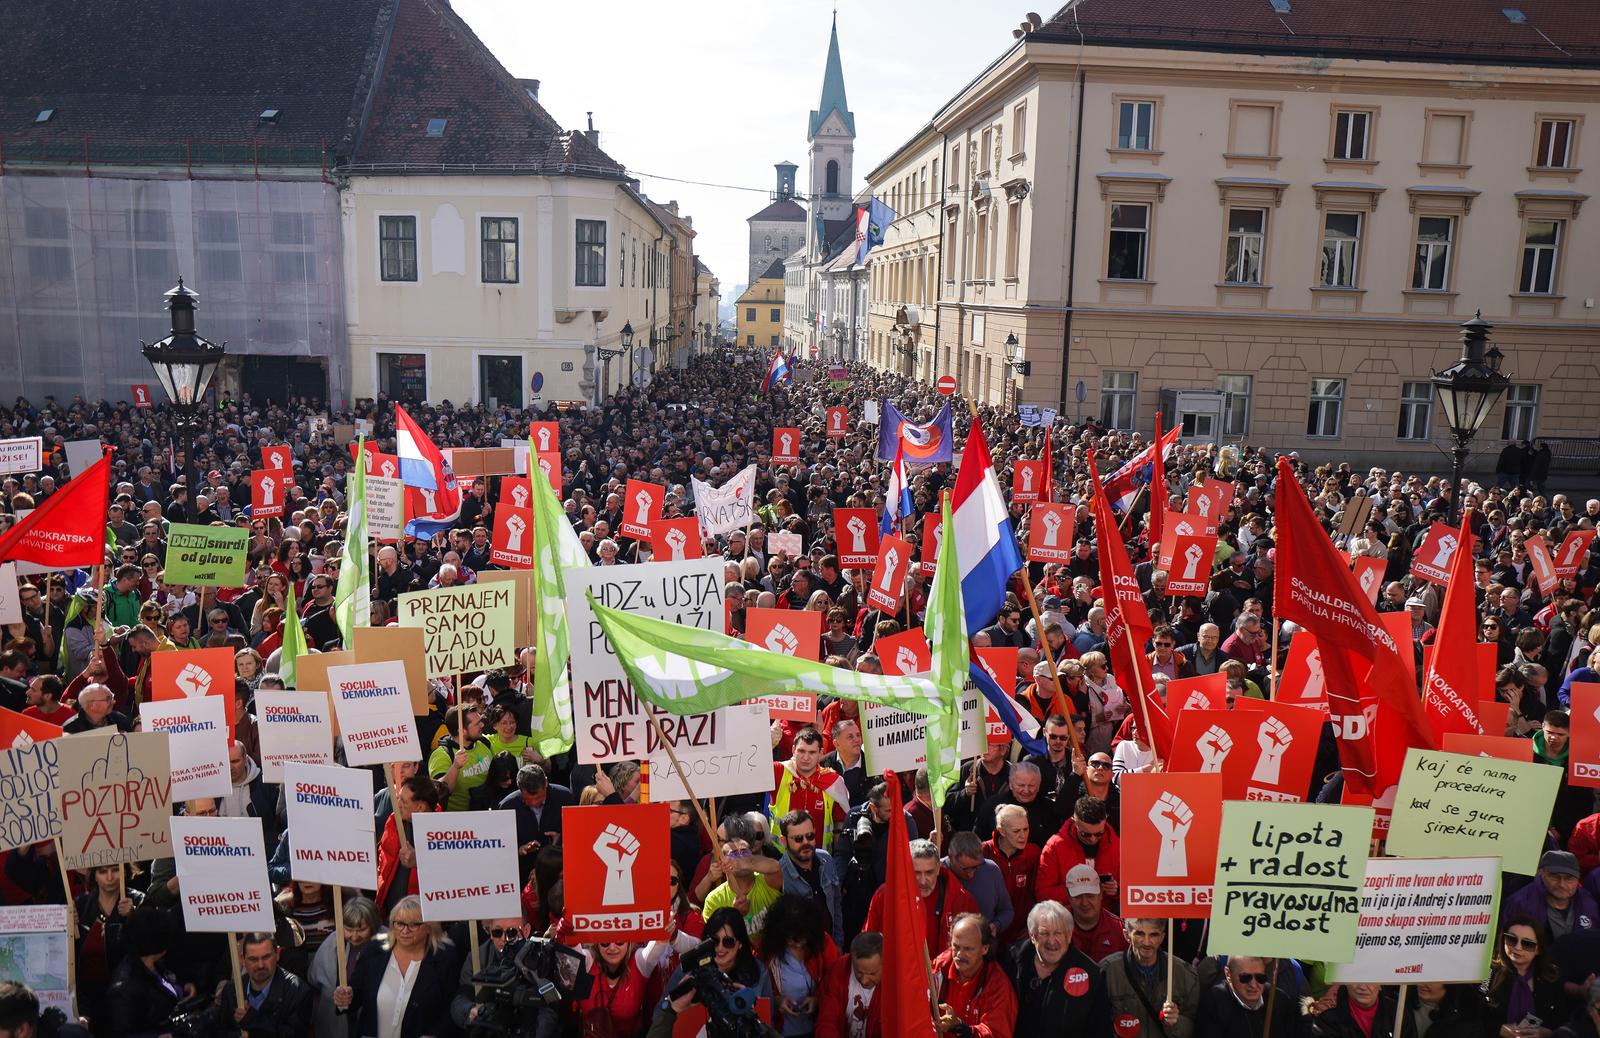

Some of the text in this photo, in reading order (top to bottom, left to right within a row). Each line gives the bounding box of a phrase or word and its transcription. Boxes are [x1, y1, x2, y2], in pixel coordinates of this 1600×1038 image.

[25, 530, 94, 544] MOKRATSKA
[625, 524, 645, 535] Dosta
[208, 538, 246, 550] smrdi
[181, 552, 234, 565] od glave
[494, 552, 531, 564] Dosta je!
[842, 556, 866, 564] Dosta
[1031, 549, 1068, 559] Dosta je!
[923, 562, 937, 570] Dos
[1416, 564, 1440, 578] Dosta
[588, 573, 722, 610] HDZ-u USTA
[1170, 582, 1204, 592] Dosta je!
[406, 589, 509, 617] PRIZNAJEM
[870, 590, 886, 604] Dosta
[1291, 590, 1339, 619] PARTIJA
[425, 612, 486, 634] SAMO
[424, 628, 496, 654] VLADU
[340, 680, 378, 691] SOCIJAL
[342, 686, 400, 700] DEMOKRATI.
[792, 697, 810, 711] je!
[1427, 686, 1452, 718] TSKE
[265, 706, 301, 715] SOCIJAL
[152, 715, 194, 728] SOCIJAL
[266, 714, 323, 723] DEMOKRATI.
[867, 718, 874, 730] u
[348, 724, 409, 743] RUBIKON JE
[590, 711, 716, 759] SVE DRAZI
[878, 736, 885, 748] u
[886, 724, 928, 746] MAMIĆE
[990, 723, 1006, 735] je!
[356, 736, 409, 752] PRIJEĐEN!
[650, 744, 759, 781] RADOSTI?
[1456, 760, 1473, 775] će
[1483, 768, 1518, 782] nama
[1576, 764, 1600, 777] Do
[296, 782, 339, 797] SOCIJAL
[1434, 780, 1506, 799] procedura
[62, 776, 172, 820] POZDRAV
[296, 793, 364, 810] DEMOKRATI.
[1410, 798, 1505, 825] kad se gura
[82, 812, 168, 854] AP-u
[426, 830, 478, 841] SOCIJAL
[1252, 820, 1343, 856] lipota
[184, 836, 230, 847] SOCIJAL
[428, 839, 506, 850] DEMOKRATI.
[185, 846, 256, 857] DEMOKRATI.
[296, 849, 370, 863] IMA NADE!
[1250, 851, 1350, 879] radost
[1364, 873, 1484, 891] zagrli me Ivan oko vrata
[188, 890, 262, 906] RUBIKON JE
[424, 882, 516, 903] VRIJEME JE!
[1130, 888, 1214, 905] Dosta je!
[1224, 890, 1359, 916] pravosudna
[1378, 895, 1388, 910] ja
[1396, 894, 1406, 910] ja
[1412, 894, 1448, 910] Andrej
[1448, 896, 1454, 906] s
[1455, 893, 1493, 906] Ivanom
[197, 904, 261, 917] PRIJEĐEN!
[574, 914, 662, 930] Dosta je!
[1242, 910, 1330, 937] gadost
[1384, 914, 1414, 930] skupa
[1416, 913, 1447, 927] svima
[1448, 915, 1460, 926] na
[1462, 912, 1492, 926] muku
[1388, 934, 1402, 948] se,
[1404, 932, 1448, 950] smijemo
[1449, 934, 1460, 946] se
[1460, 931, 1488, 948] puku
[1068, 972, 1089, 984] SDP
[1120, 1018, 1140, 1028] SDP
